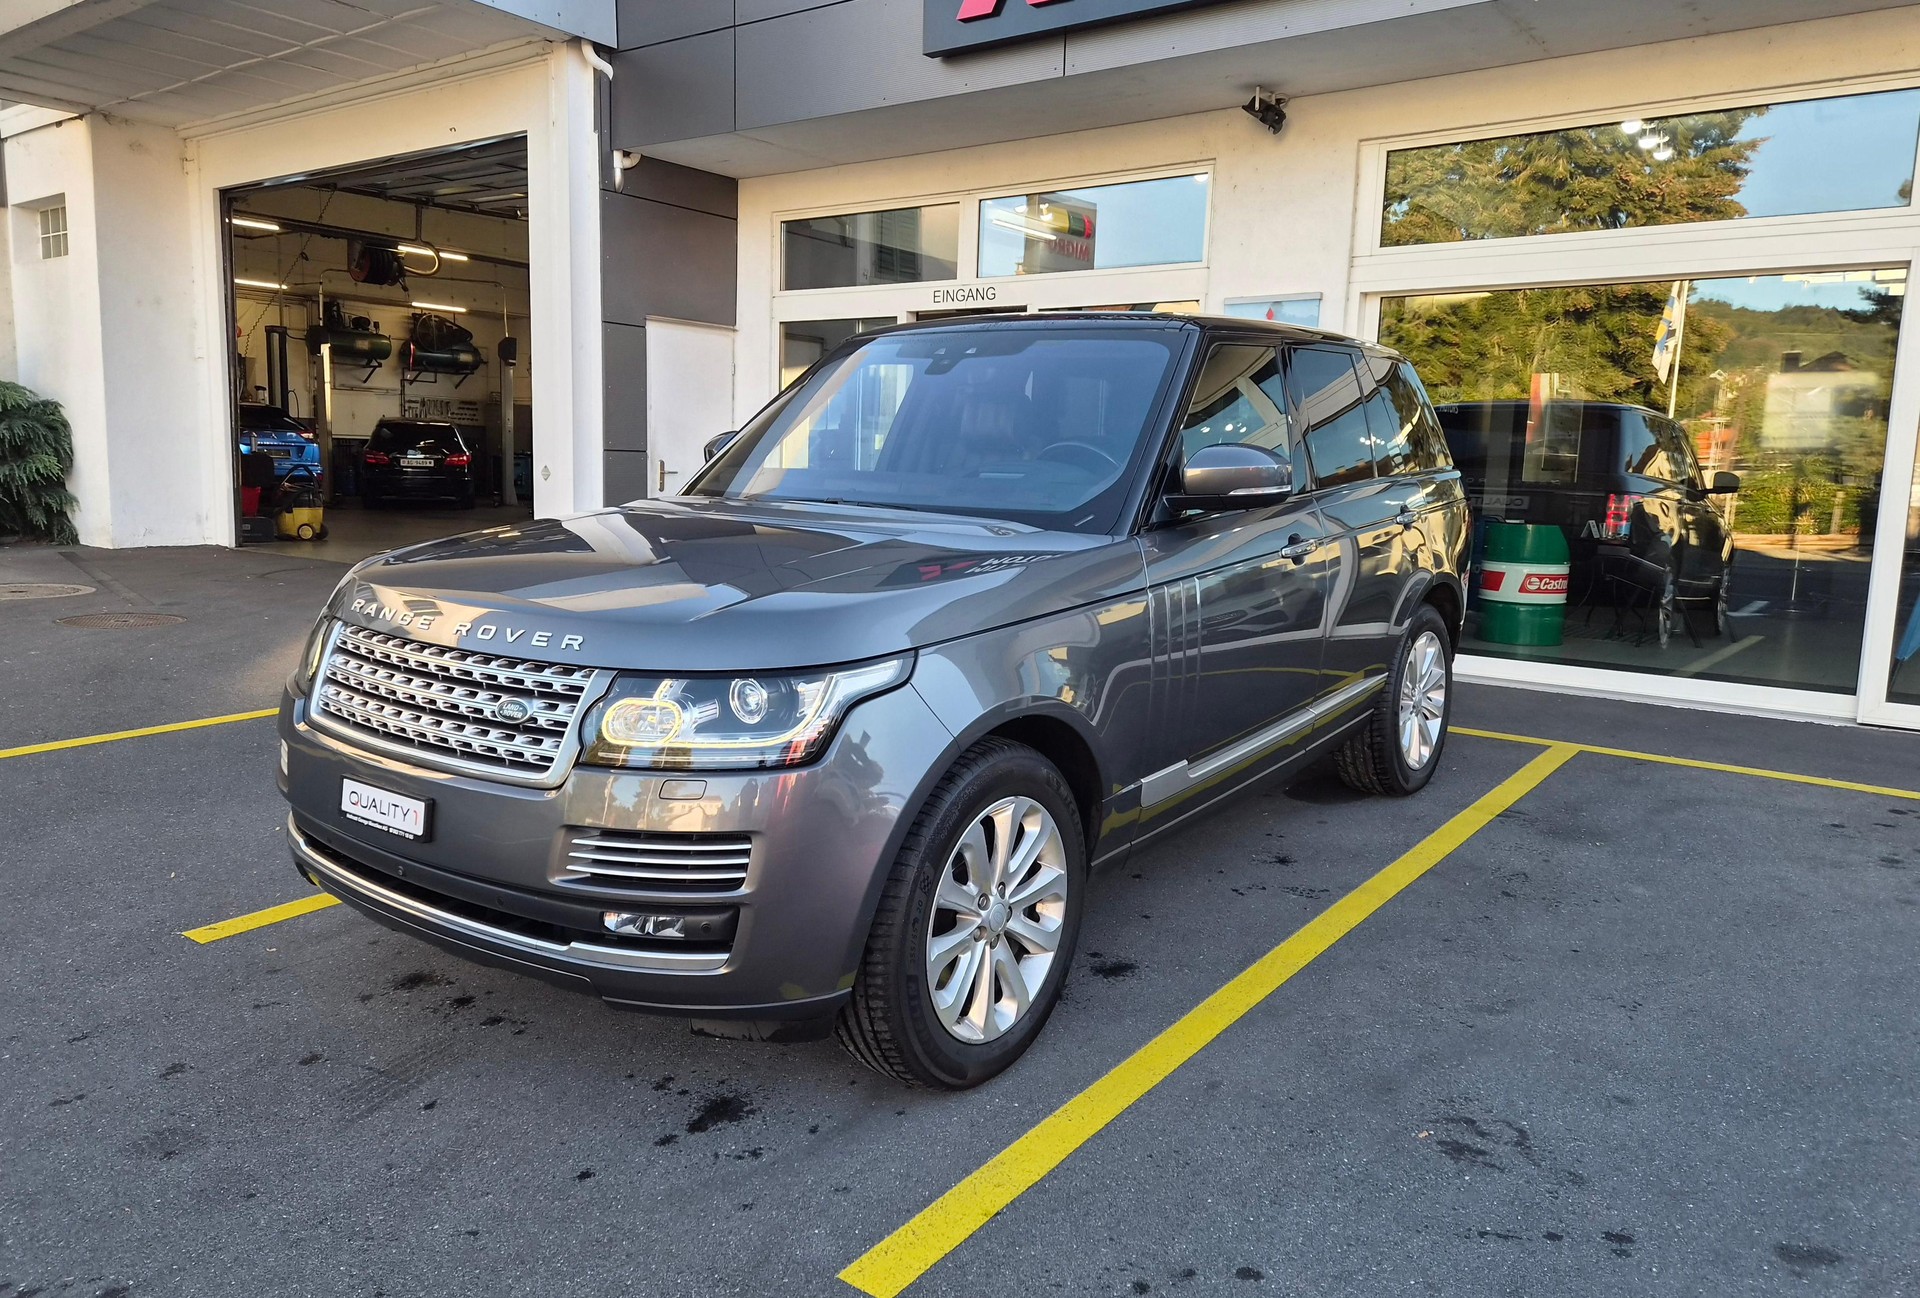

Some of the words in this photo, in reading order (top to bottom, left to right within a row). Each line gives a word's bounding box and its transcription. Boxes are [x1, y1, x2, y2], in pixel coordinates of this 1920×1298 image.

[933, 286, 996, 304] EINGANG
[1540, 577, 1568, 590] Castro
[351, 598, 436, 630] RANGE
[452, 621, 585, 651] ROVER
[502, 703, 520, 711] LAND
[503, 709, 523, 719] ROVER
